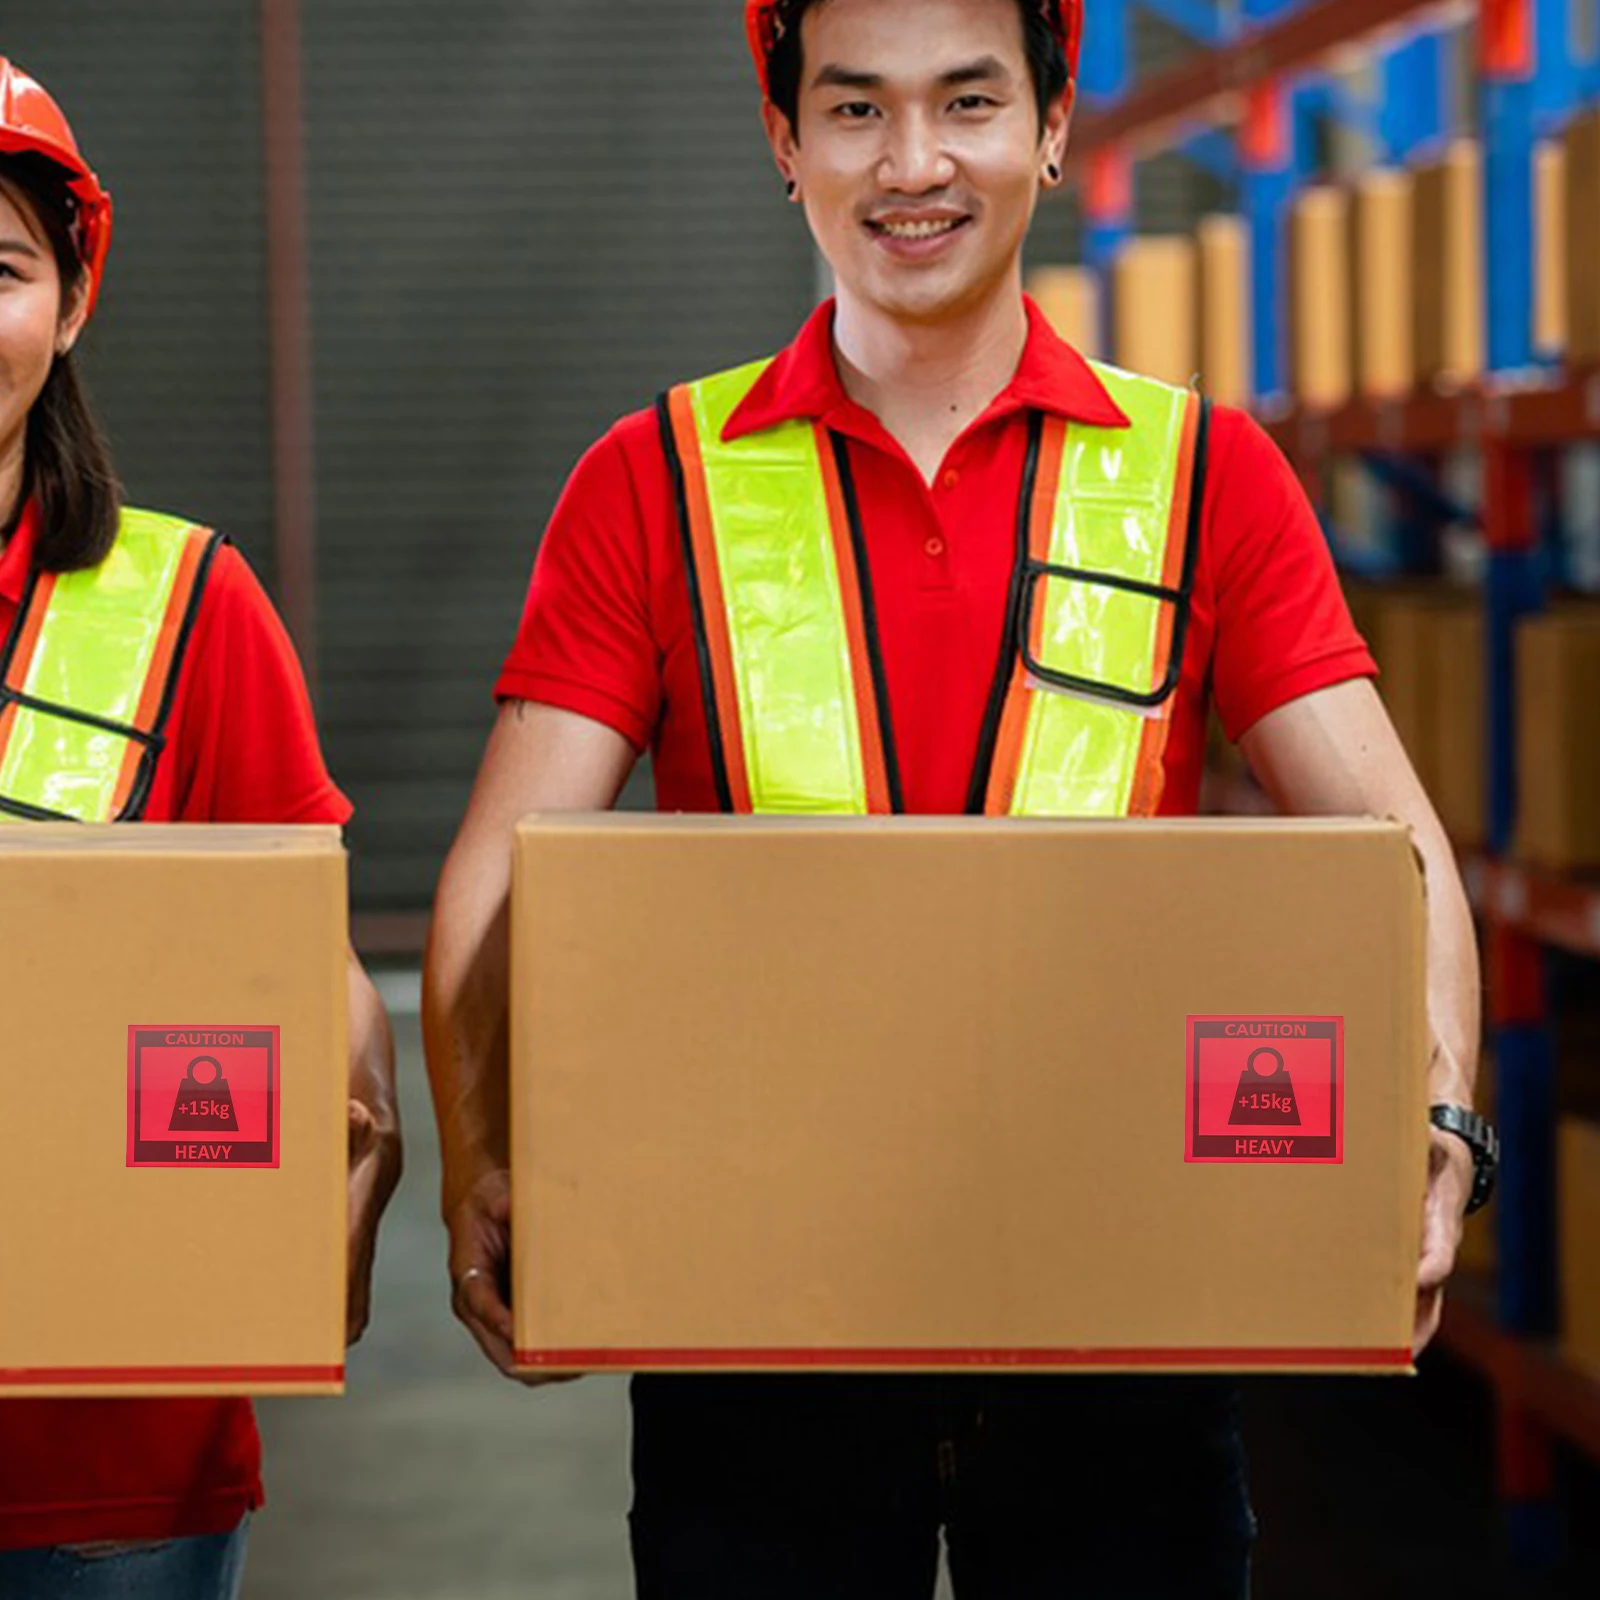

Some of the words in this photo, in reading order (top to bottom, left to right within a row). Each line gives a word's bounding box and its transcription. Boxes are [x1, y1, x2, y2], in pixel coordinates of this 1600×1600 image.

[1224, 1024, 1307, 1036] CAUTION
[165, 1033, 244, 1045] CAUTION
[178, 1100, 230, 1119] +15kg
[1239, 1093, 1292, 1113] +15kg
[175, 1145, 233, 1160] HEAVY
[1235, 1139, 1295, 1155] HEAVY
